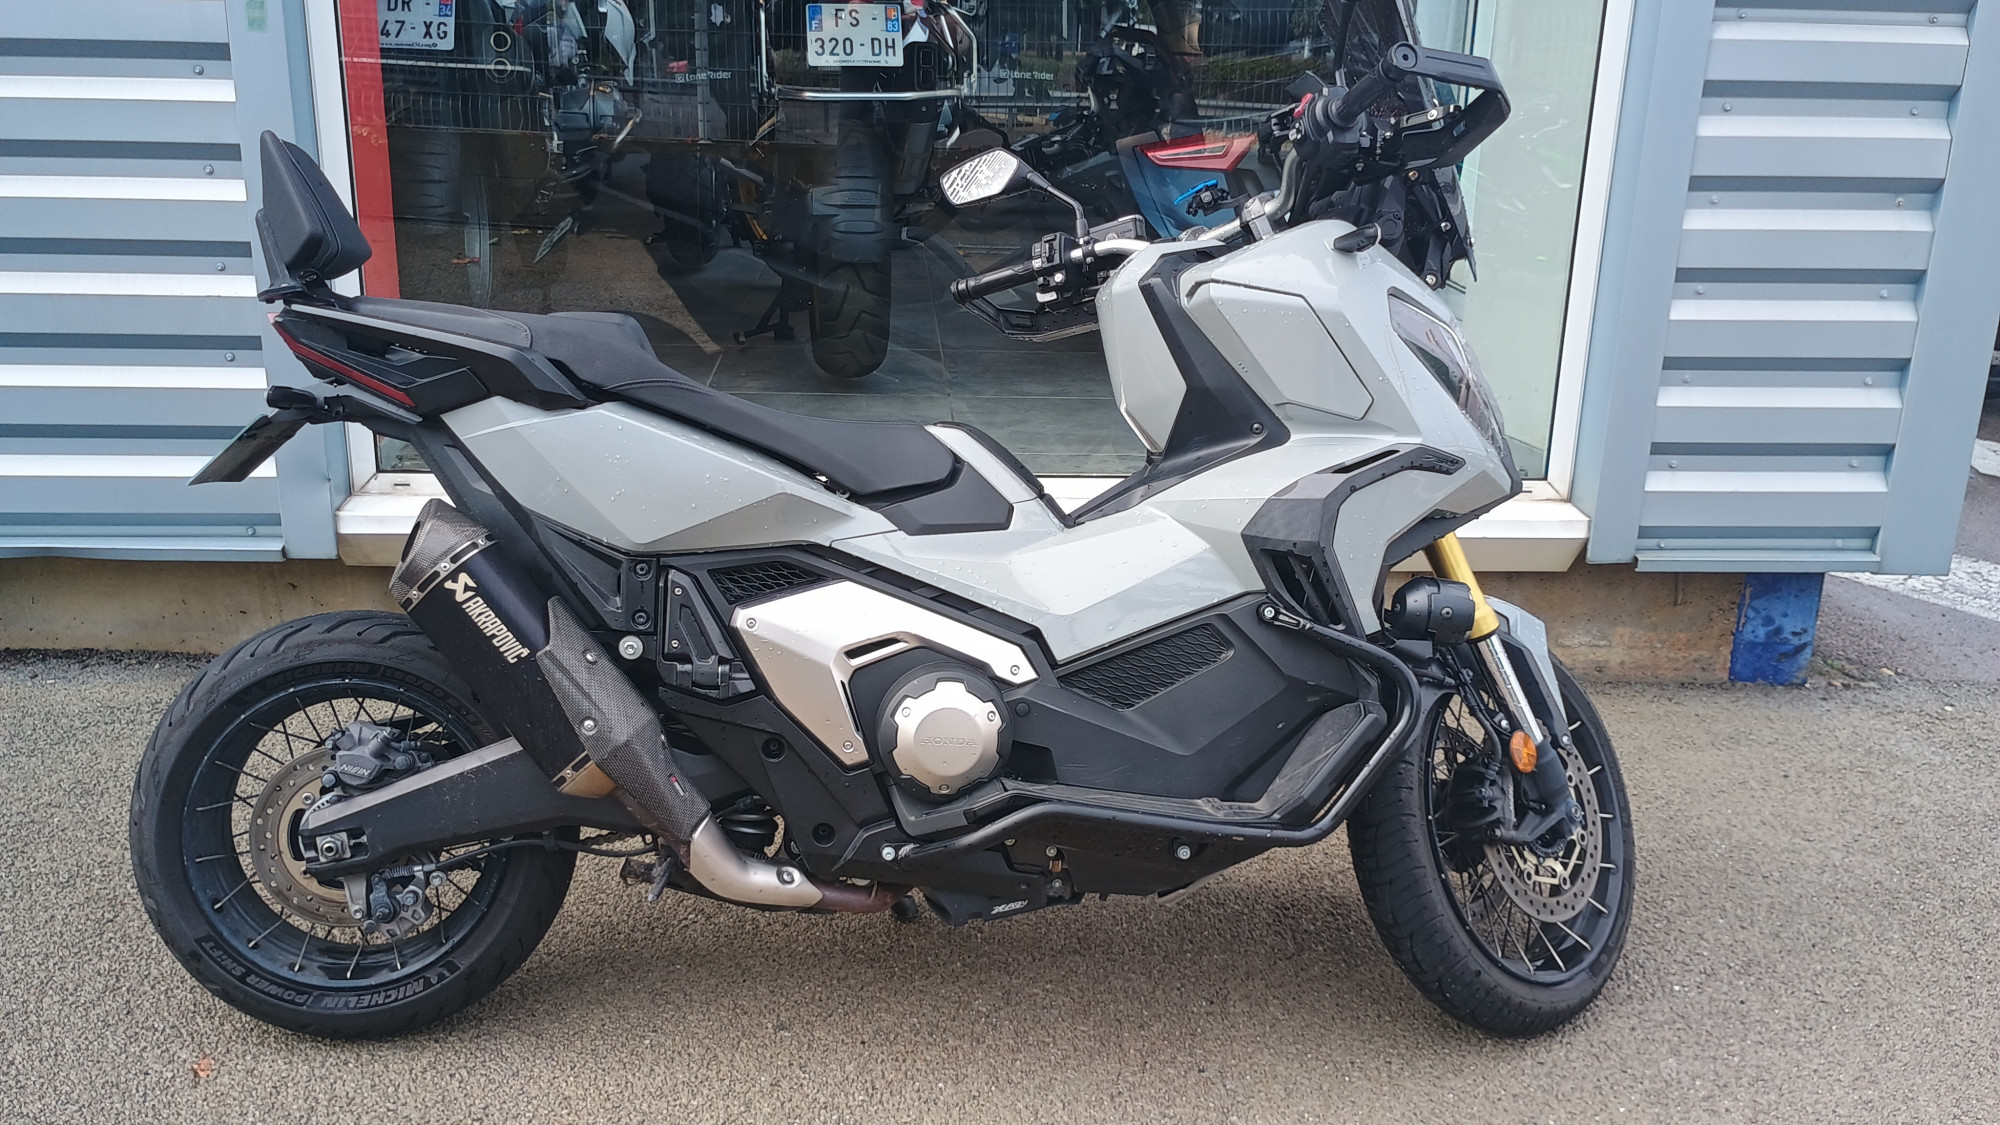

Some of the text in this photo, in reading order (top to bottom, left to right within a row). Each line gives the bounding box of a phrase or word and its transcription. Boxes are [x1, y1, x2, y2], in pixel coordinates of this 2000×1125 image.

[387, 0, 411, 12] DR
[440, 5, 451, 15] 34
[834, 8, 860, 27] FS
[811, 20, 820, 31] F
[887, 21, 899, 31] 83
[920, 736, 979, 747] HONDA
[245, 974, 310, 1003] POWER
[319, 977, 425, 1008] MICHELIN
